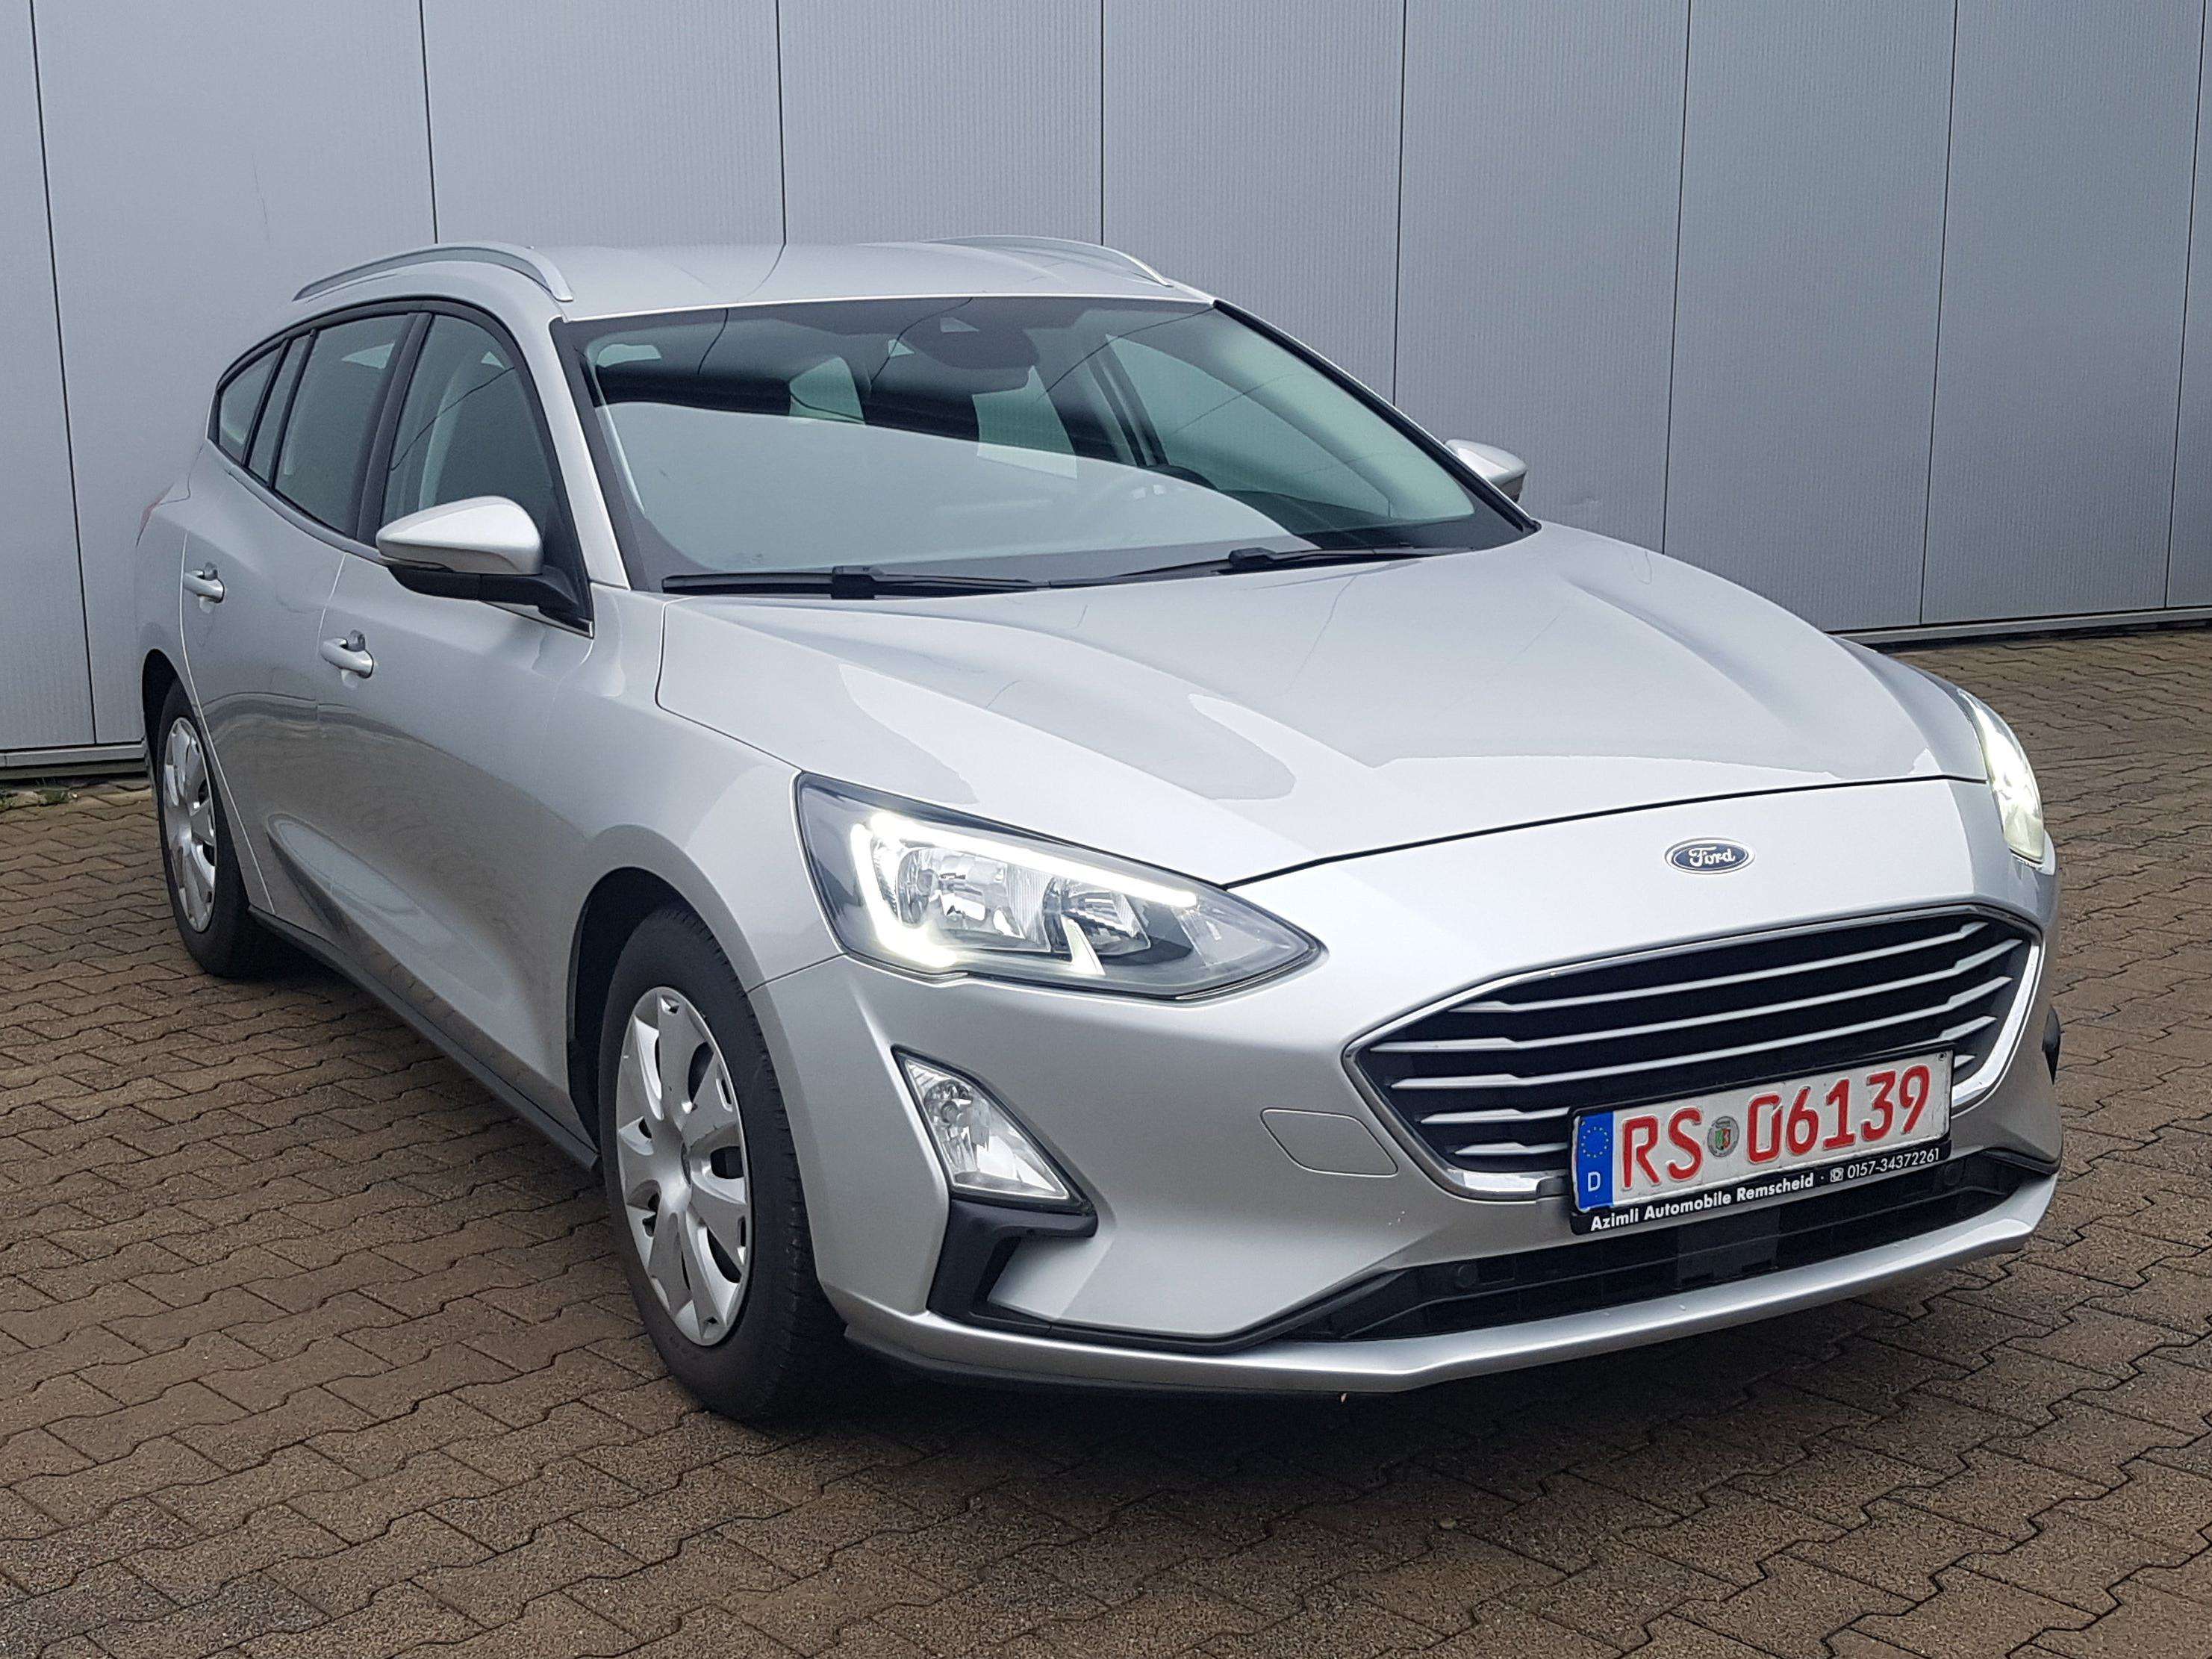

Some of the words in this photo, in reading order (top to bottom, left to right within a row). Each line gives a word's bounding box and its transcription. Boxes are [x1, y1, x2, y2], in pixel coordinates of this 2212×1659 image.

[1688, 846, 1735, 867] Ford
[1622, 1106, 1703, 1189] RS
[1747, 1064, 1931, 1163] 06139
[1587, 1171, 1601, 1192] D
[1644, 1190, 1732, 1220] Automobile
[1736, 1172, 1814, 1201] Remscheid
[1847, 1148, 1940, 1179] 0157-34372261
